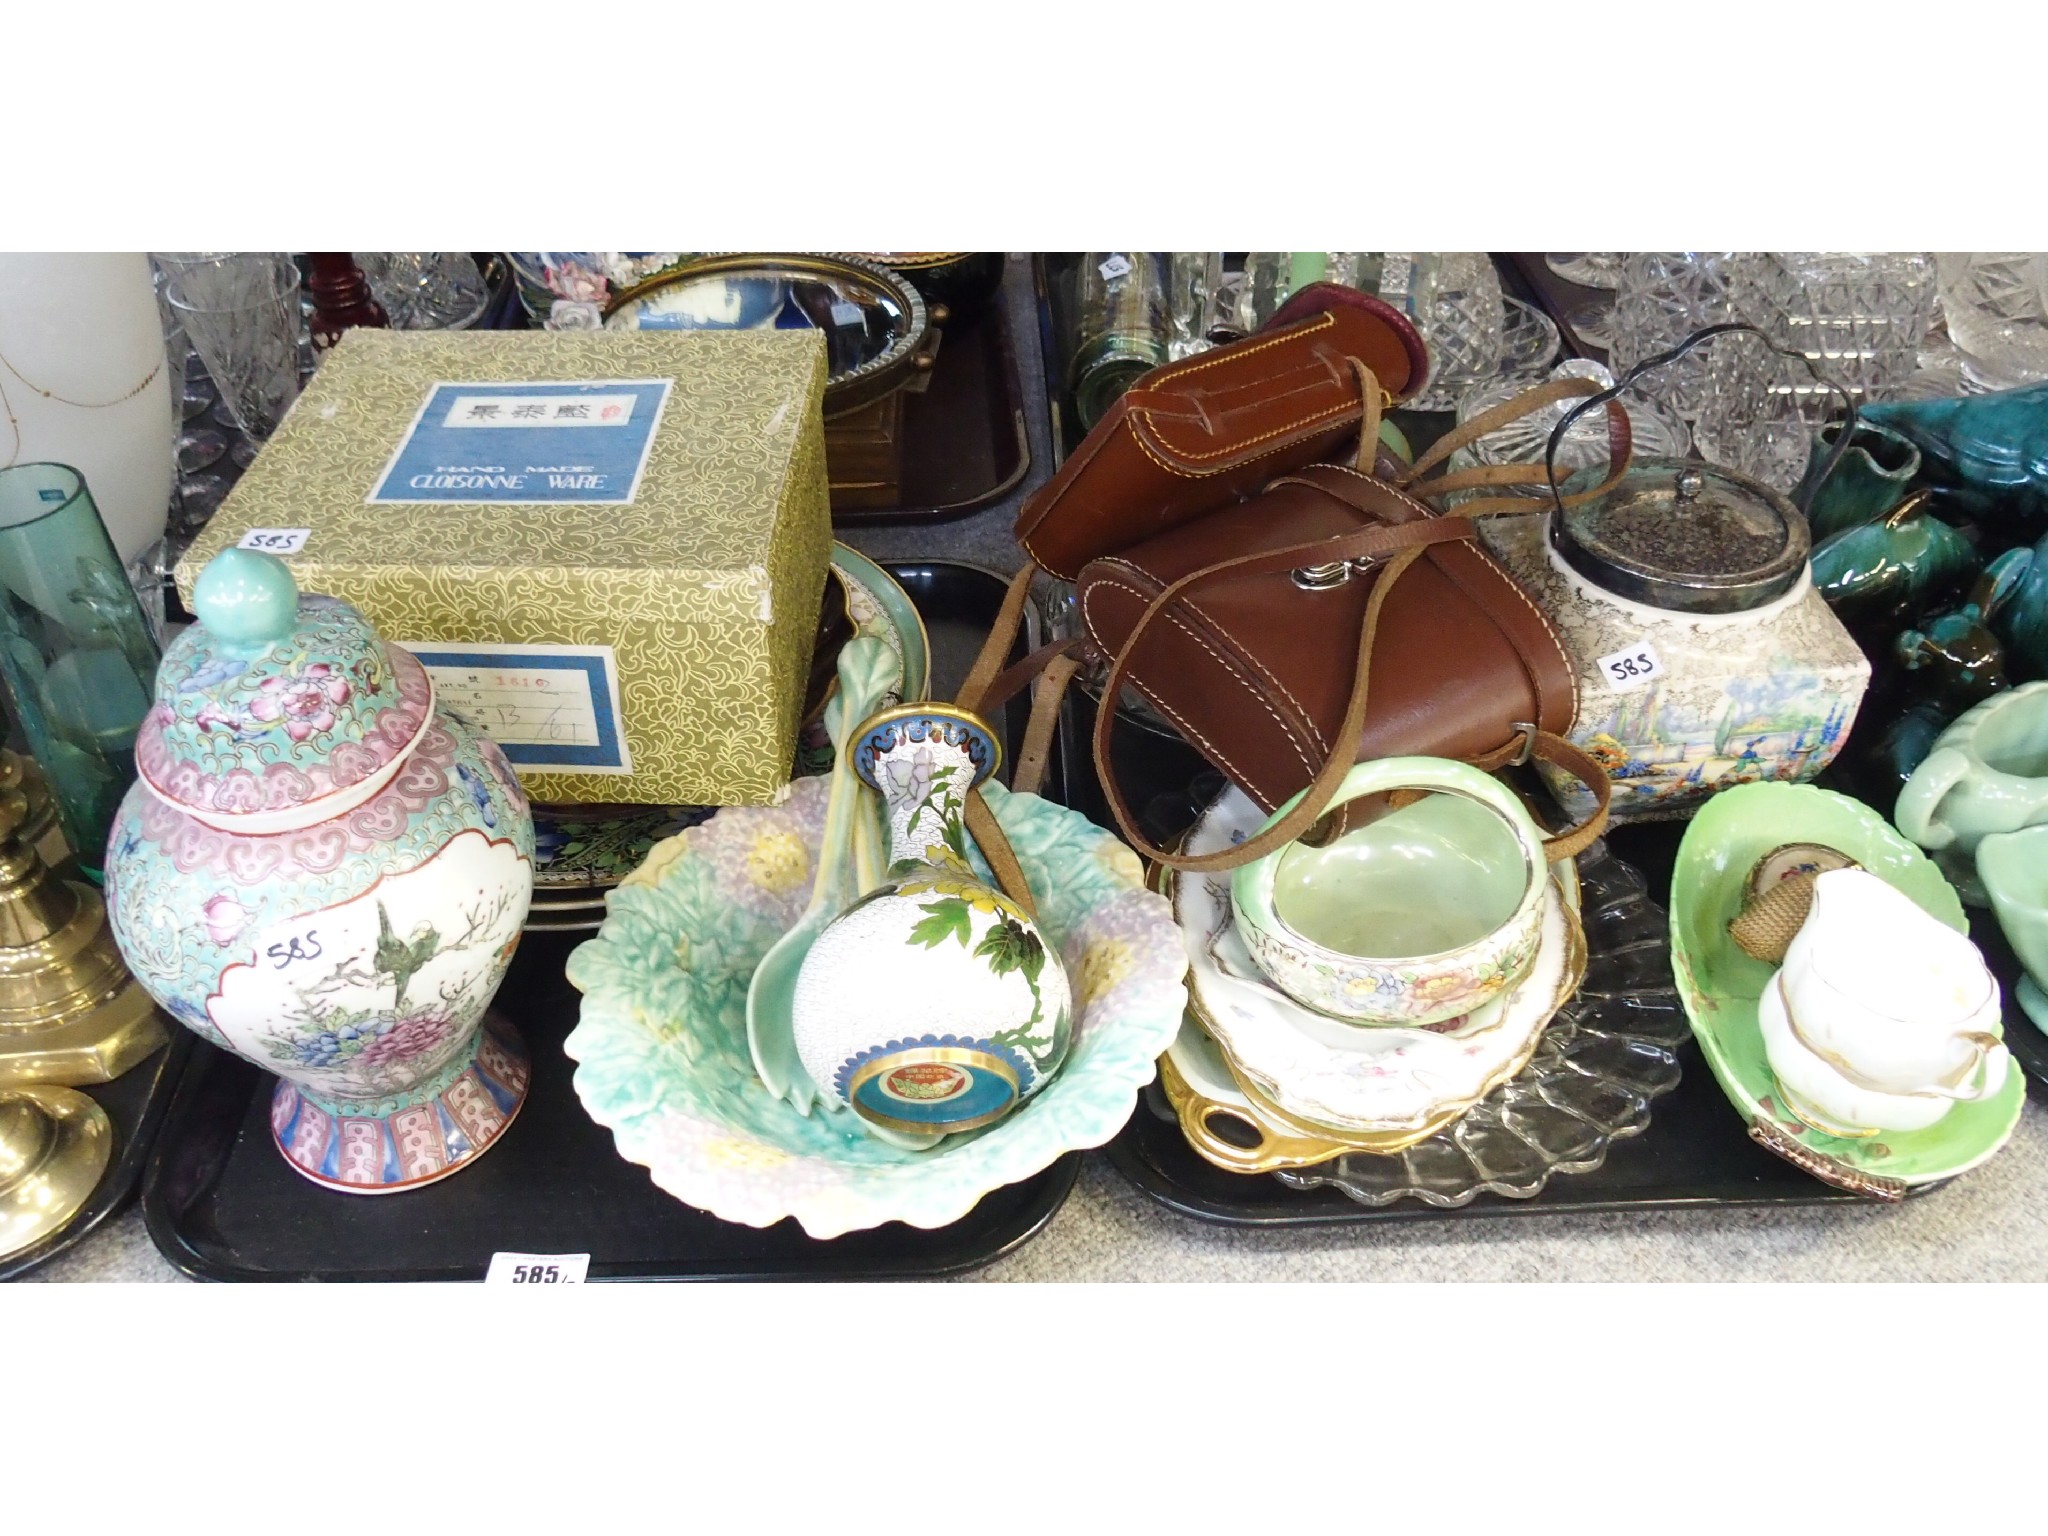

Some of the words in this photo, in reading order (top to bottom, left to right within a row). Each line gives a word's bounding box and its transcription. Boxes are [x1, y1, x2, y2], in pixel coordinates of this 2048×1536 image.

[409, 474, 528, 489] CLOISONNE
[549, 474, 608, 489] WARE
[1610, 653, 1653, 681] 585
[267, 929, 322, 970] 585
